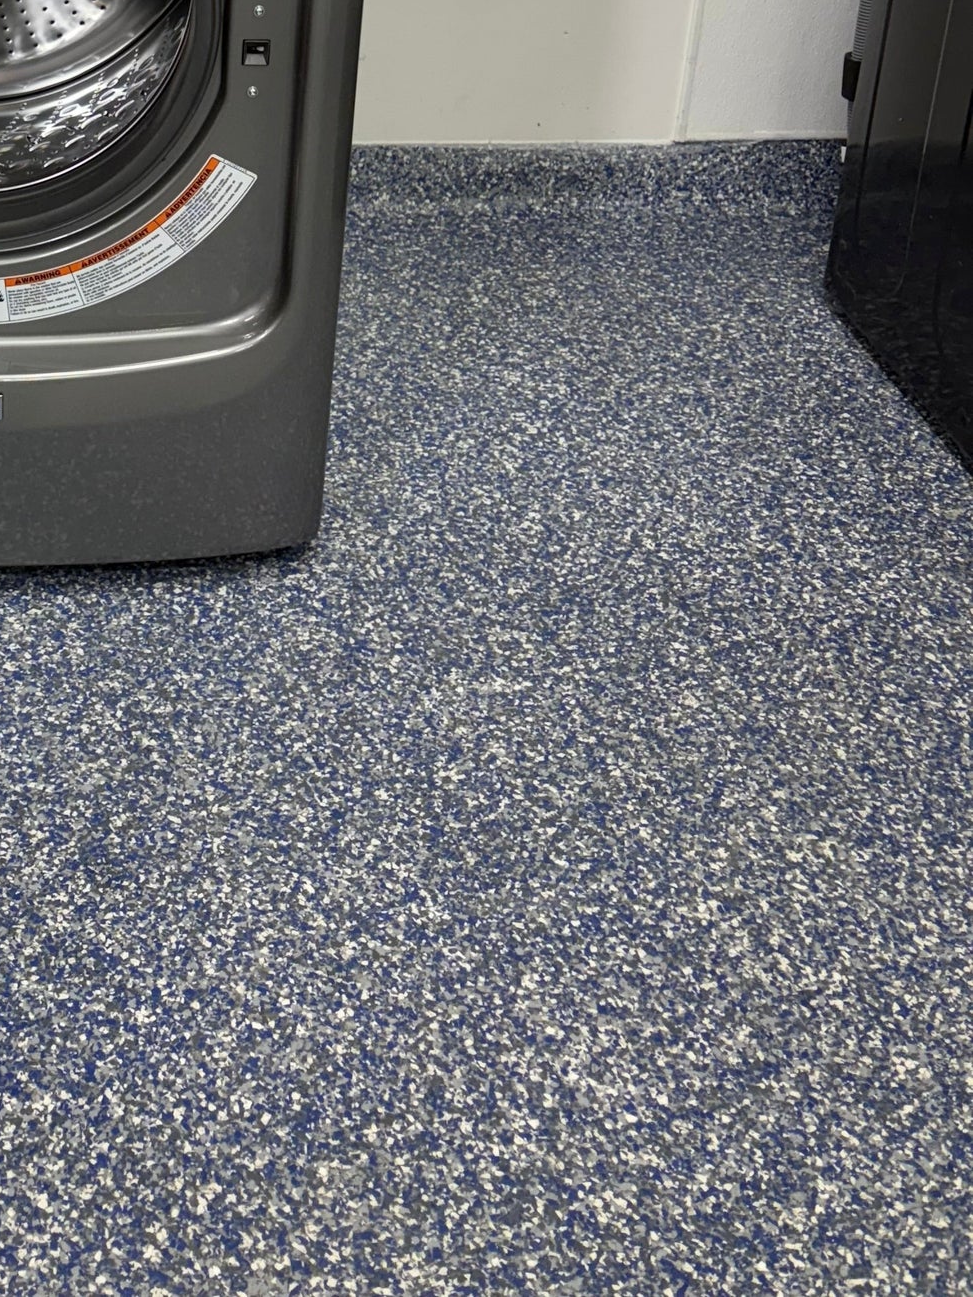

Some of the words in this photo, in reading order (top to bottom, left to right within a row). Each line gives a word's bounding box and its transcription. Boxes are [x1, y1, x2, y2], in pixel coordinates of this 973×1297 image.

[170, 168, 212, 214] ADVERTENCIA
[87, 228, 149, 266] AVERTISSEMENT
[21, 269, 61, 283] WARNING
